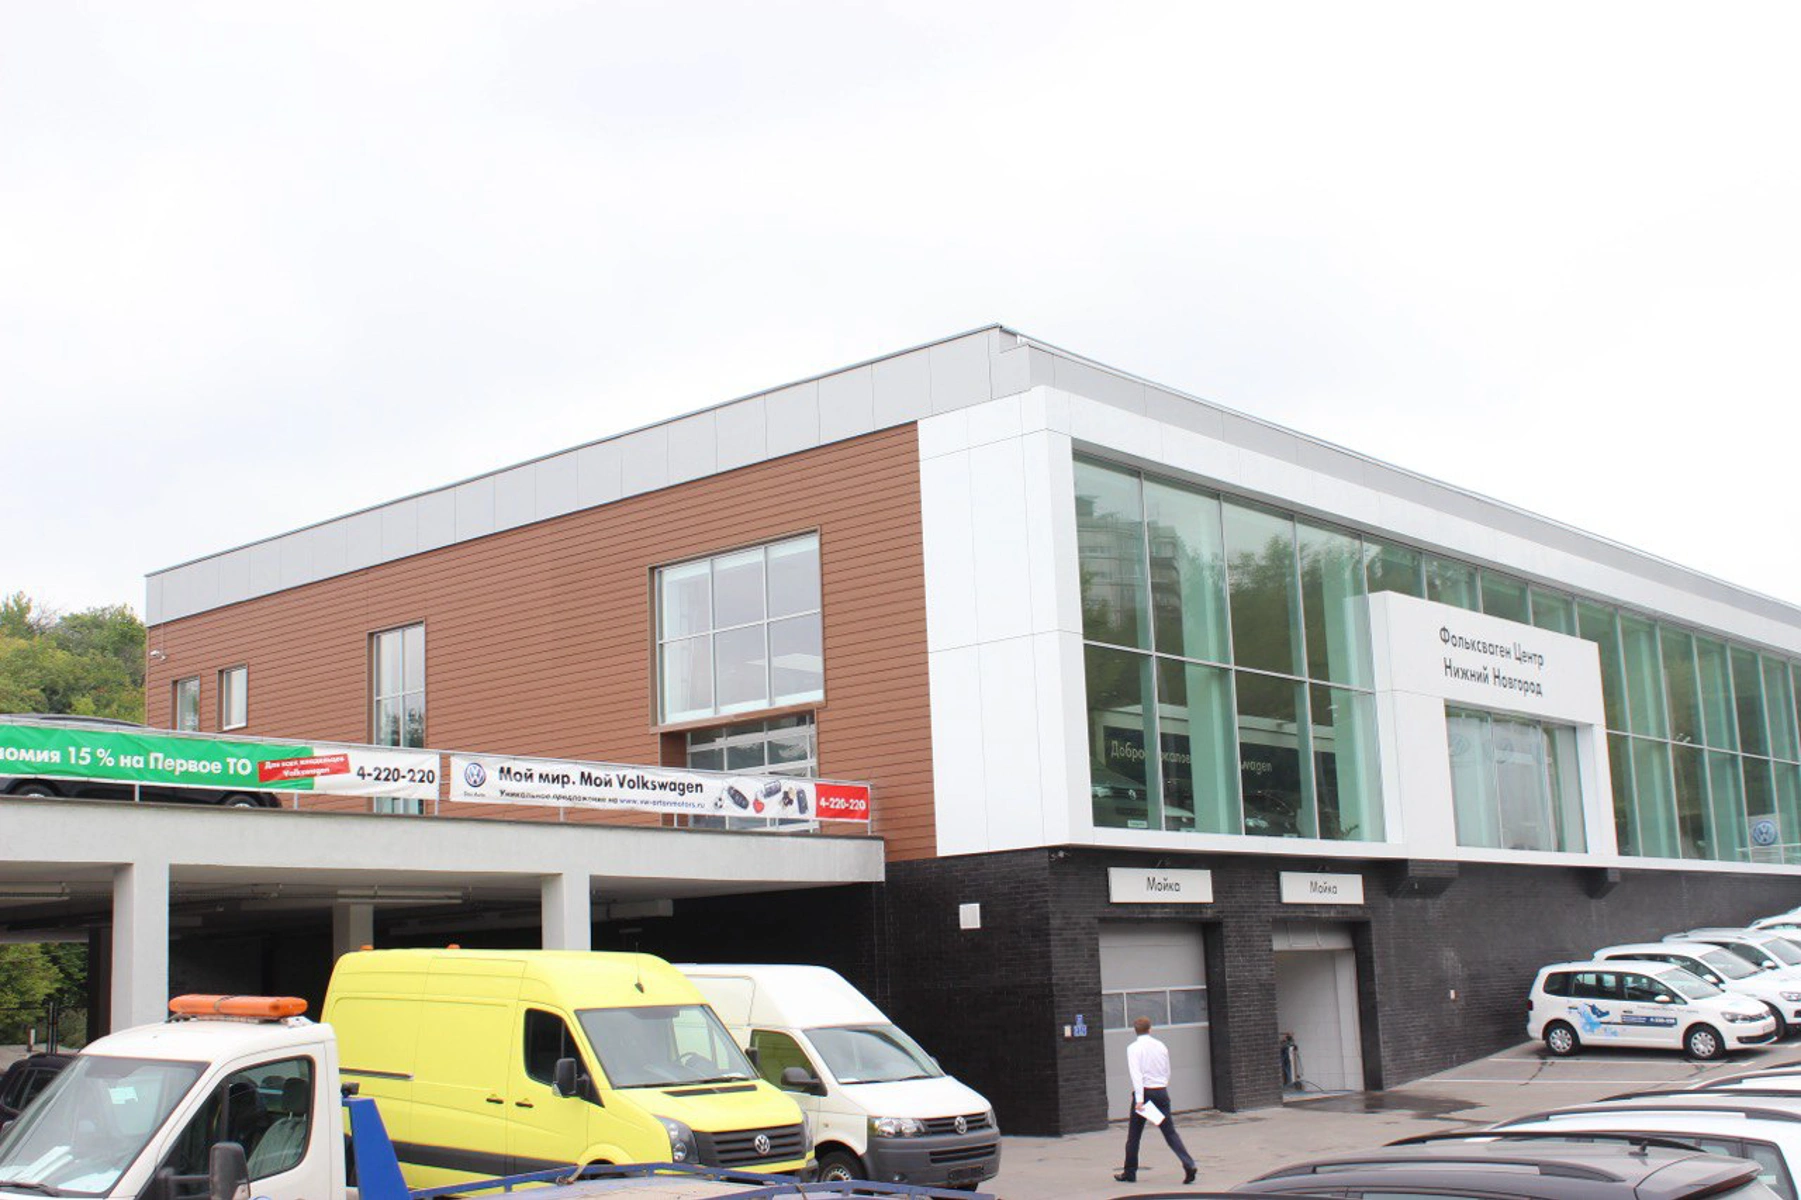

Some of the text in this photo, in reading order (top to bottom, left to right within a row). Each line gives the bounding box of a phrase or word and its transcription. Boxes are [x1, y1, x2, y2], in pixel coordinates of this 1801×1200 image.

[1440, 626, 1544, 670] Фольксваген Центр
[1443, 657, 1543, 697] Нижний Новгород
[68, 746, 92, 766] 15
[96, 748, 115, 767] %
[120, 755, 144, 769] на
[149, 752, 223, 776] Первое
[226, 757, 253, 776] ТО
[357, 766, 436, 784] 4-220-220
[499, 766, 703, 797] Мой мир. Мой Volkswagen
[820, 797, 867, 811] 4-220-220
[1146, 876, 1181, 892] Мойка
[1309, 880, 1338, 895] Мойка
